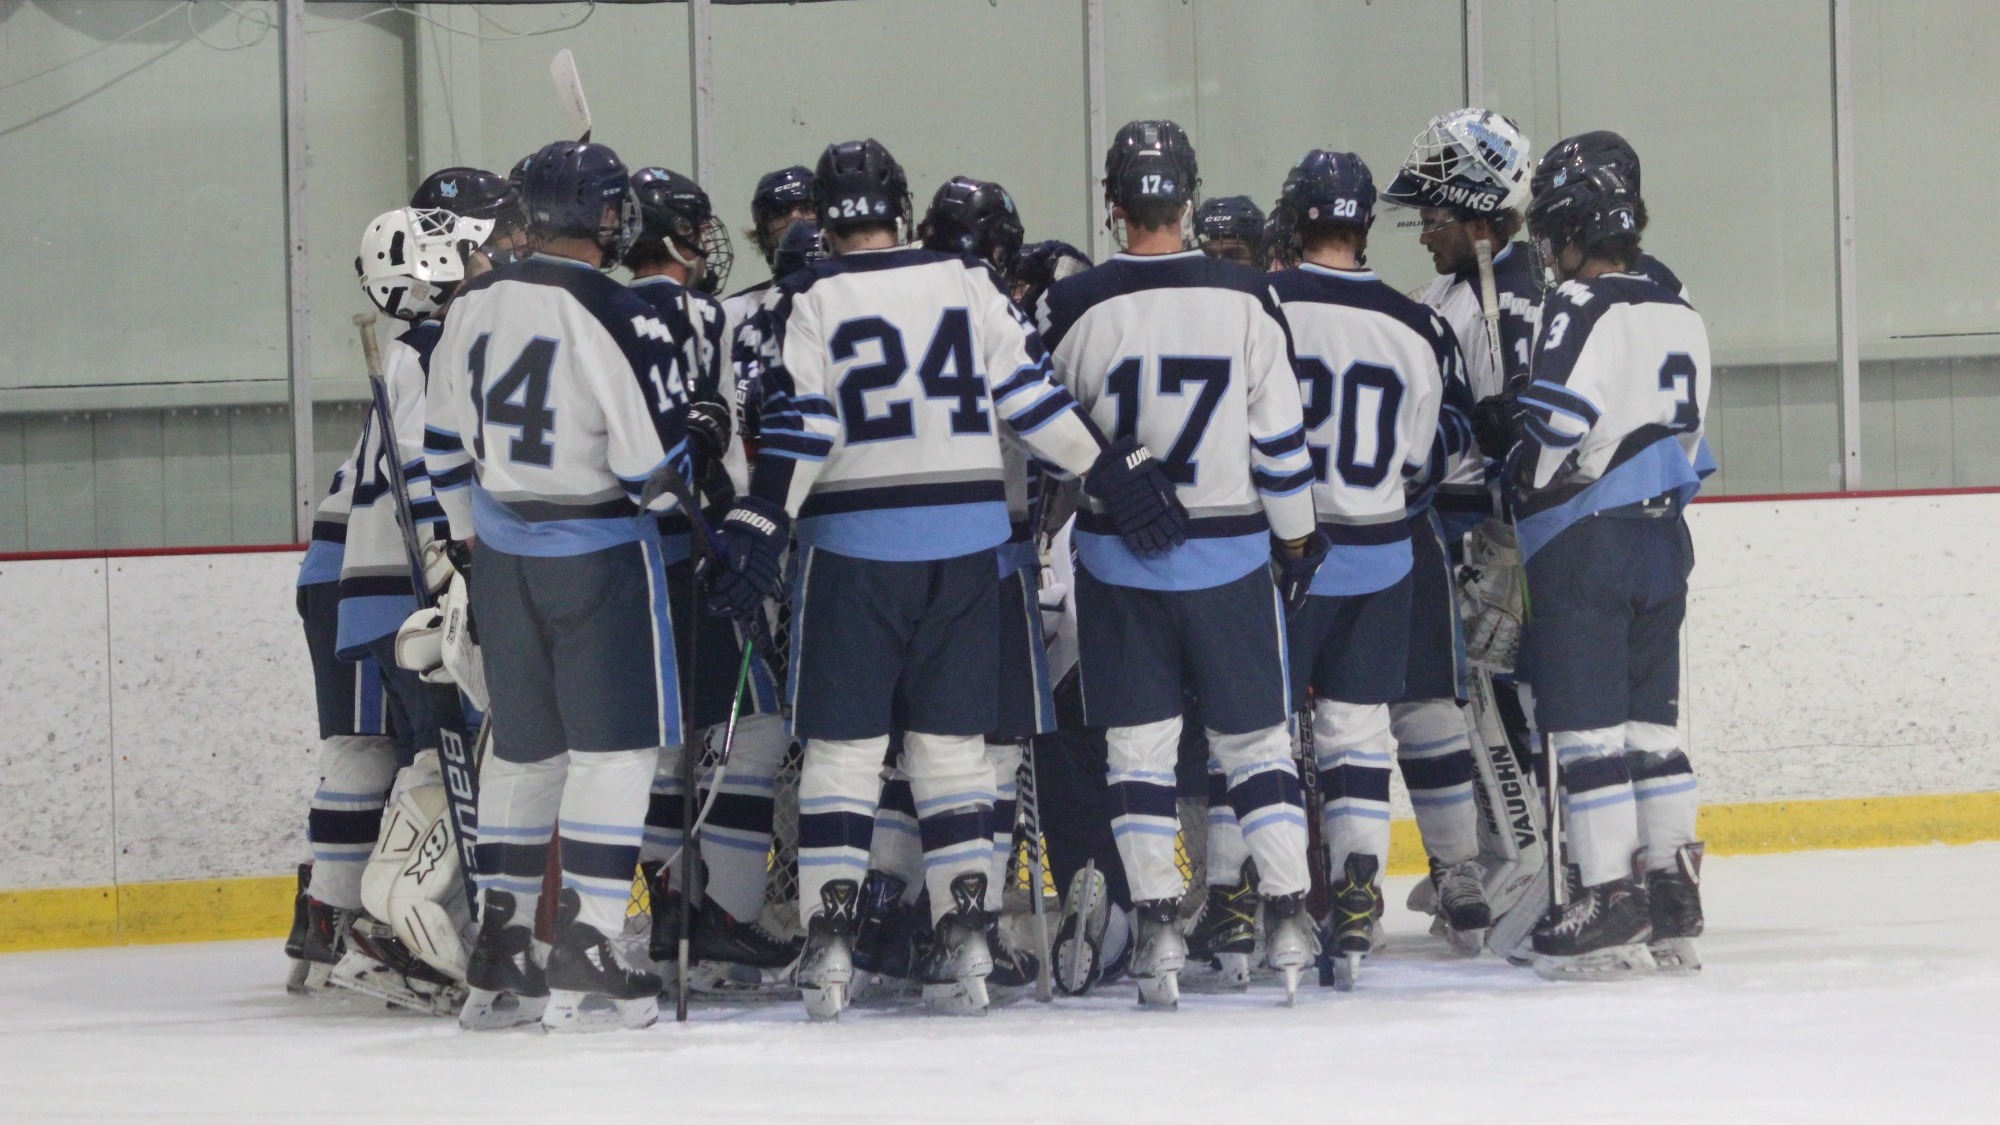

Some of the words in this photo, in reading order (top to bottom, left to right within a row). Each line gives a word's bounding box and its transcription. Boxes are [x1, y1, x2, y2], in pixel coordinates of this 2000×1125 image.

[775, 181, 801, 193] CCM
[842, 197, 870, 217] 24
[1141, 174, 1162, 194] 17
[1421, 178, 1498, 211] AWKS
[1205, 214, 1232, 223] CCM
[1333, 198, 1357, 217] 20
[1544, 312, 1571, 350] 3
[649, 358, 689, 413] 14
[829, 306, 992, 447] 24
[467, 331, 561, 470] 14
[1105, 355, 1232, 487] 17
[1296, 353, 1406, 490] 20
[1300, 711, 1317, 788] SPEED
[1489, 745, 1536, 850] VAUGHN
